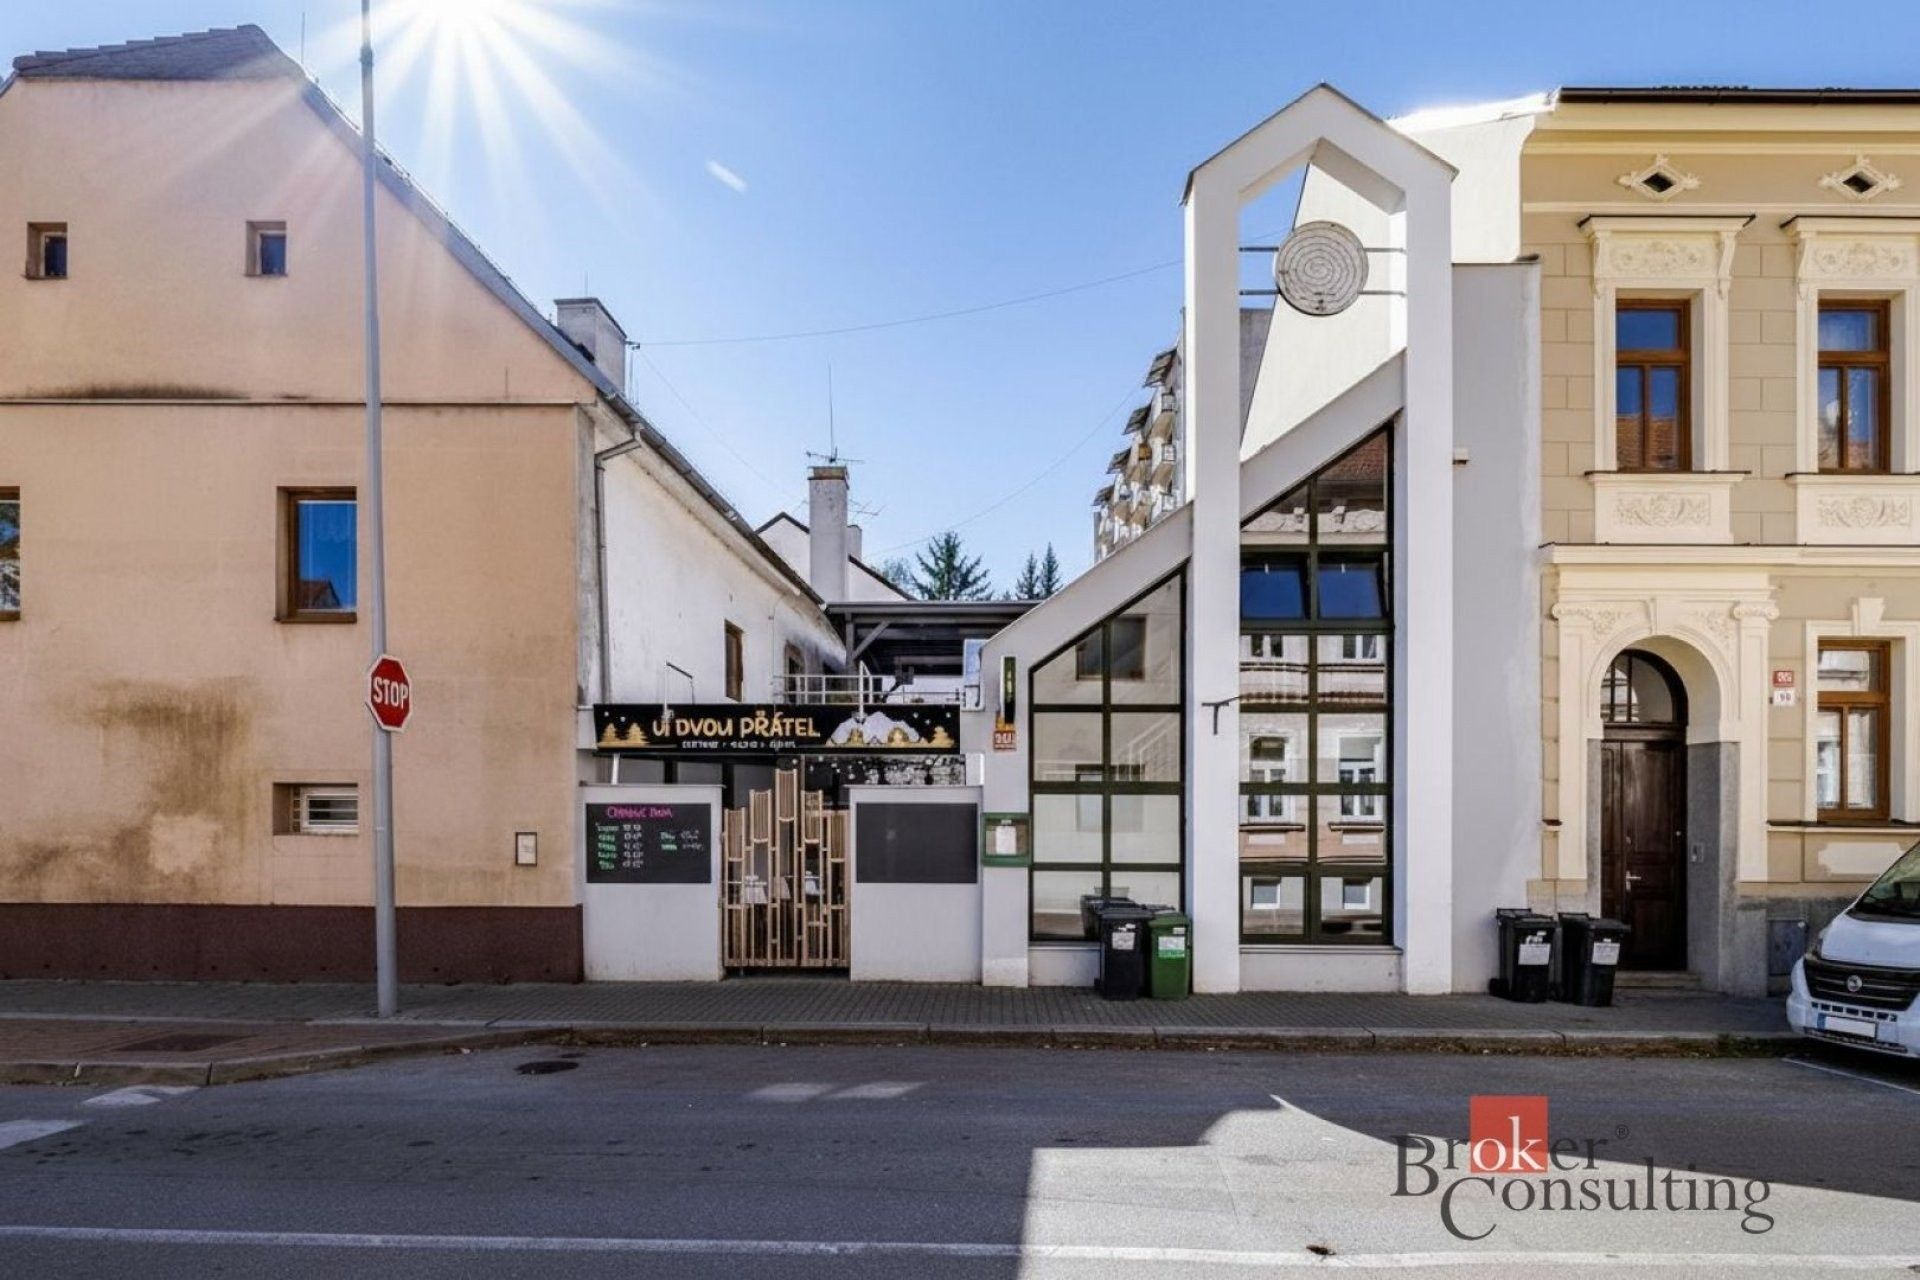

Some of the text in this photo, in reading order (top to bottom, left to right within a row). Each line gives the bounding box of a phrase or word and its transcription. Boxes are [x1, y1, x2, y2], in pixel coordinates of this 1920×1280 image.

[373, 676, 409, 709] STOP
[675, 718, 734, 737] DVOU
[740, 710, 821, 738] PŘÁTEL
